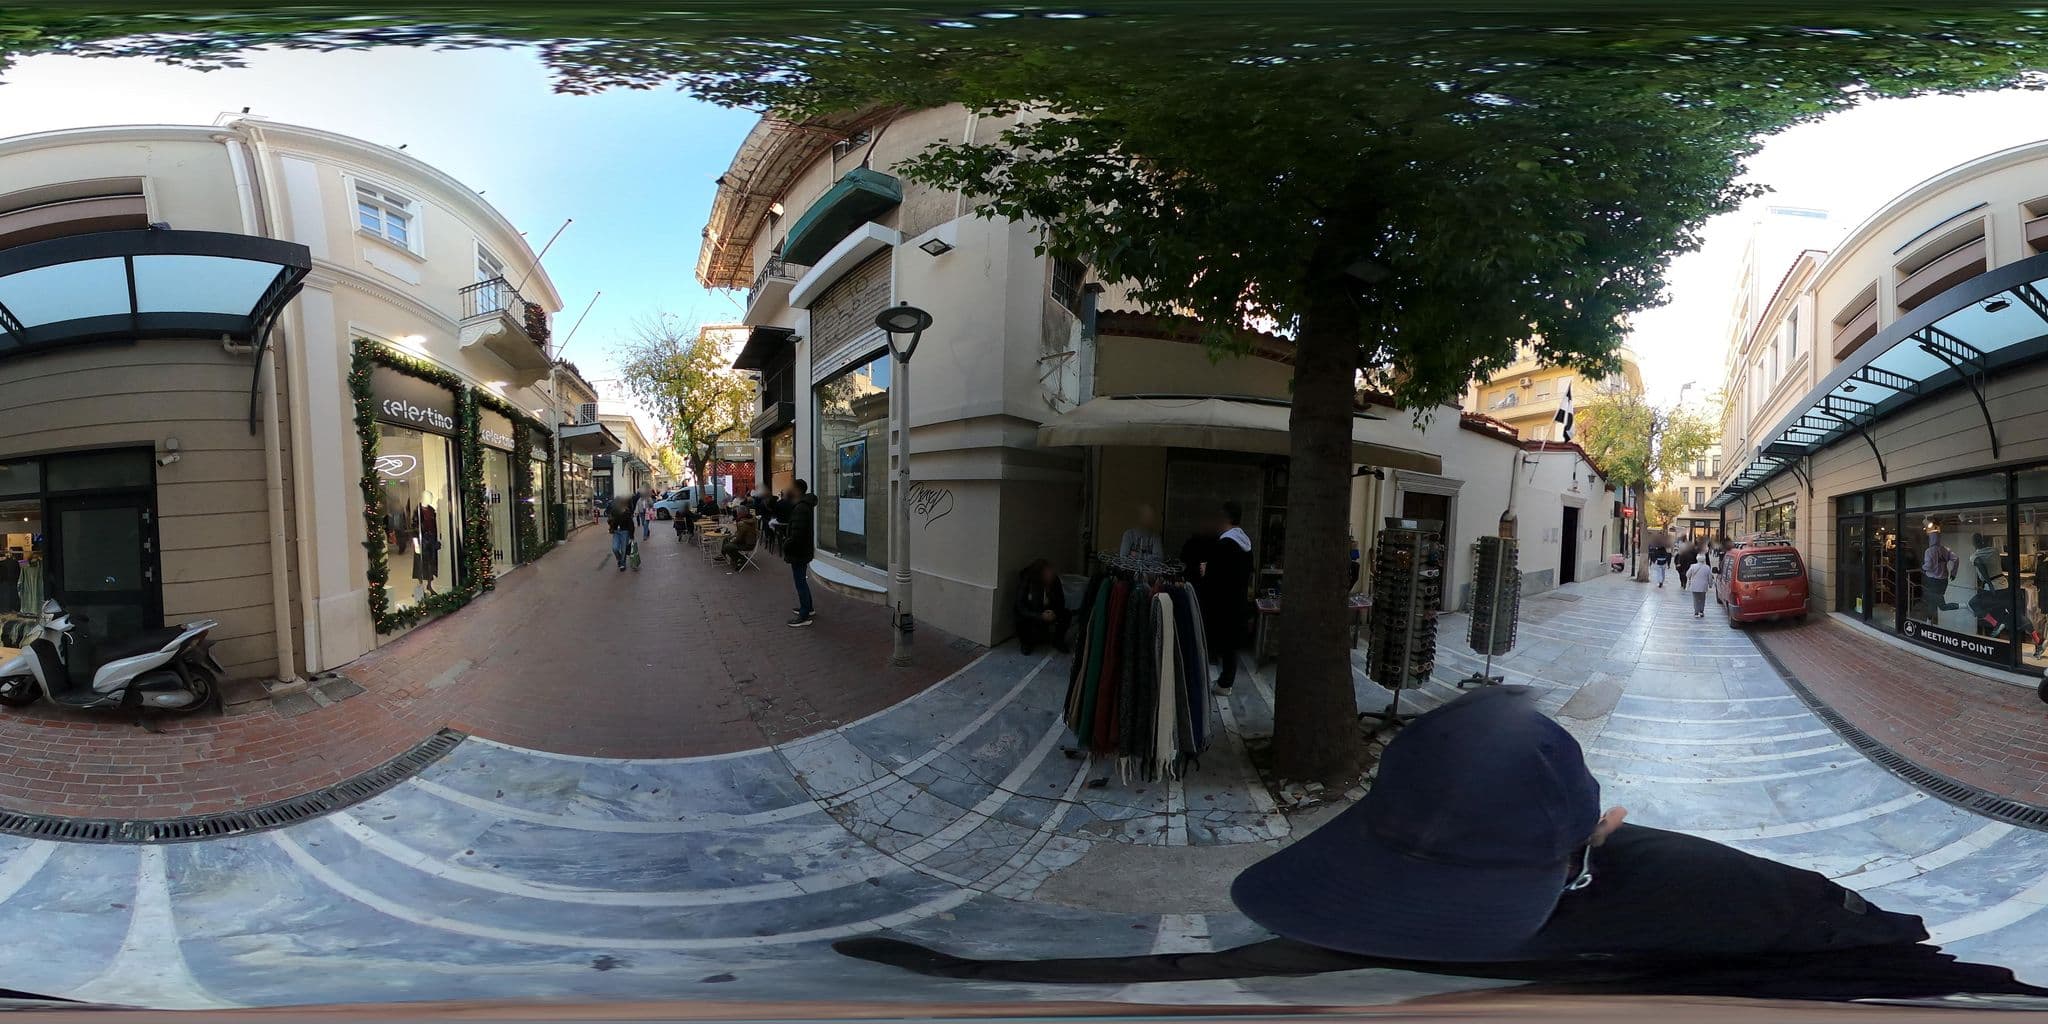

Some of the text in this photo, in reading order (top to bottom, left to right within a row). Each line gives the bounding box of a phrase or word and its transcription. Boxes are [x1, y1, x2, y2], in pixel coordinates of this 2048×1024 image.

[383, 399, 453, 430] celestino
[1921, 629, 1994, 655] MEETING POINT
